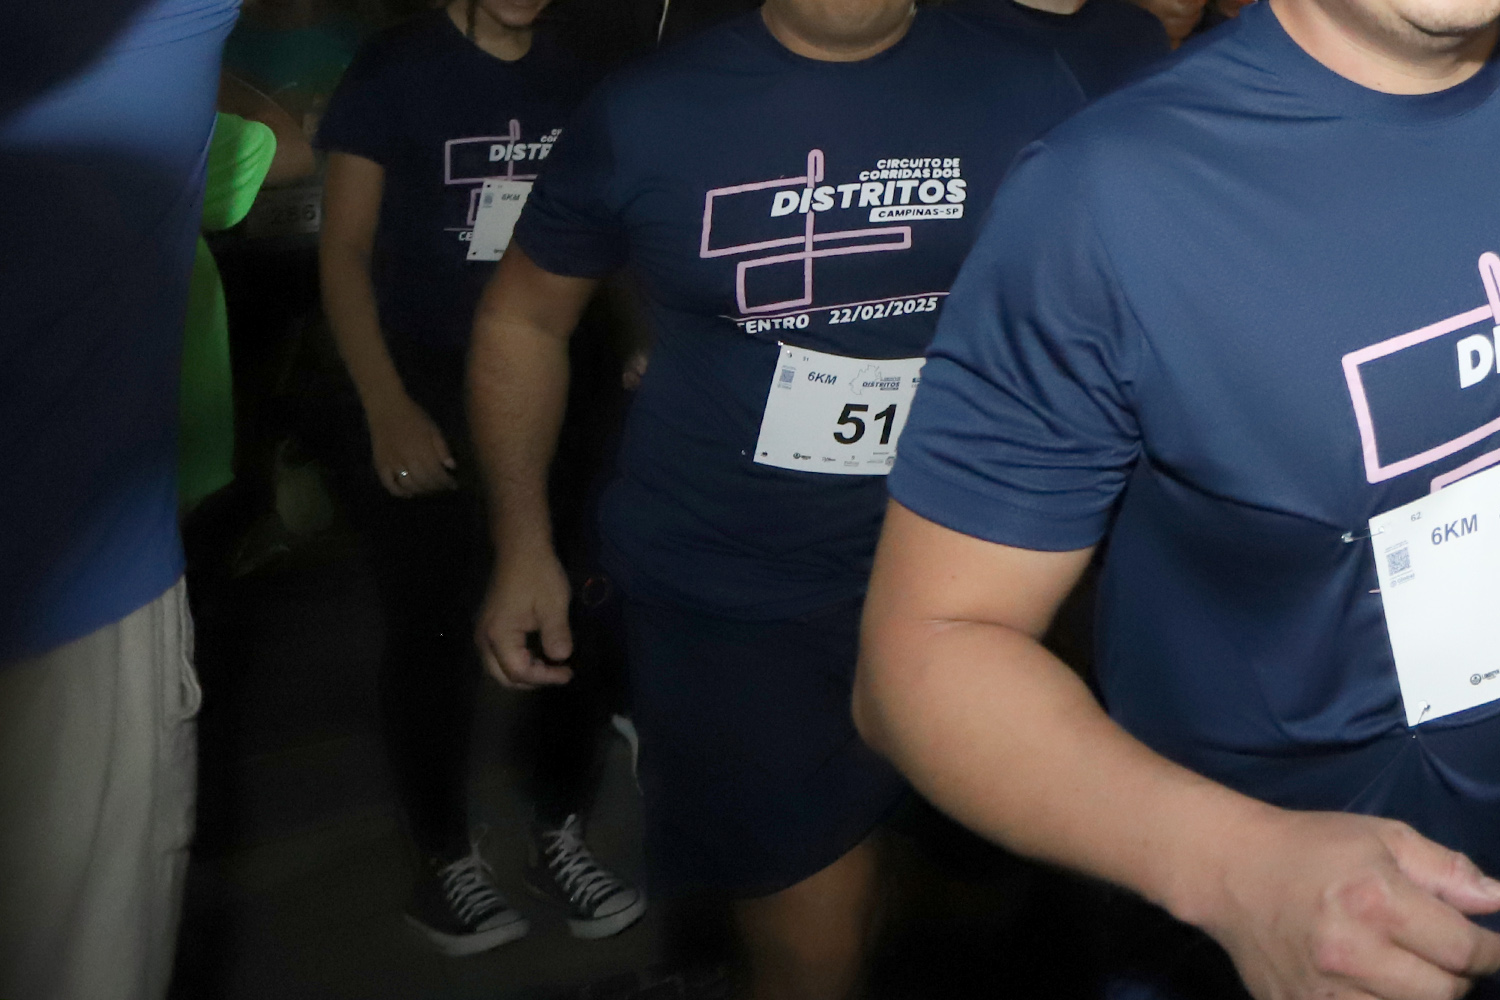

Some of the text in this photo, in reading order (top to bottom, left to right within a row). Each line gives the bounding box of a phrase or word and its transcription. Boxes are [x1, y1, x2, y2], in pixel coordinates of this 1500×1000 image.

[876, 158, 961, 170] CIRCUITO DE
[859, 168, 961, 182] CORRIDAS DOS
[770, 179, 967, 218] DISTRITOS
[878, 207, 960, 218] CAMPINAS-SP
[736, 297, 939, 334] ENTRO 22/02/2025
[807, 371, 838, 385] 6KM
[833, 403, 898, 445] 51
[1410, 511, 1422, 521] 62
[1431, 513, 1478, 545] 6KM
